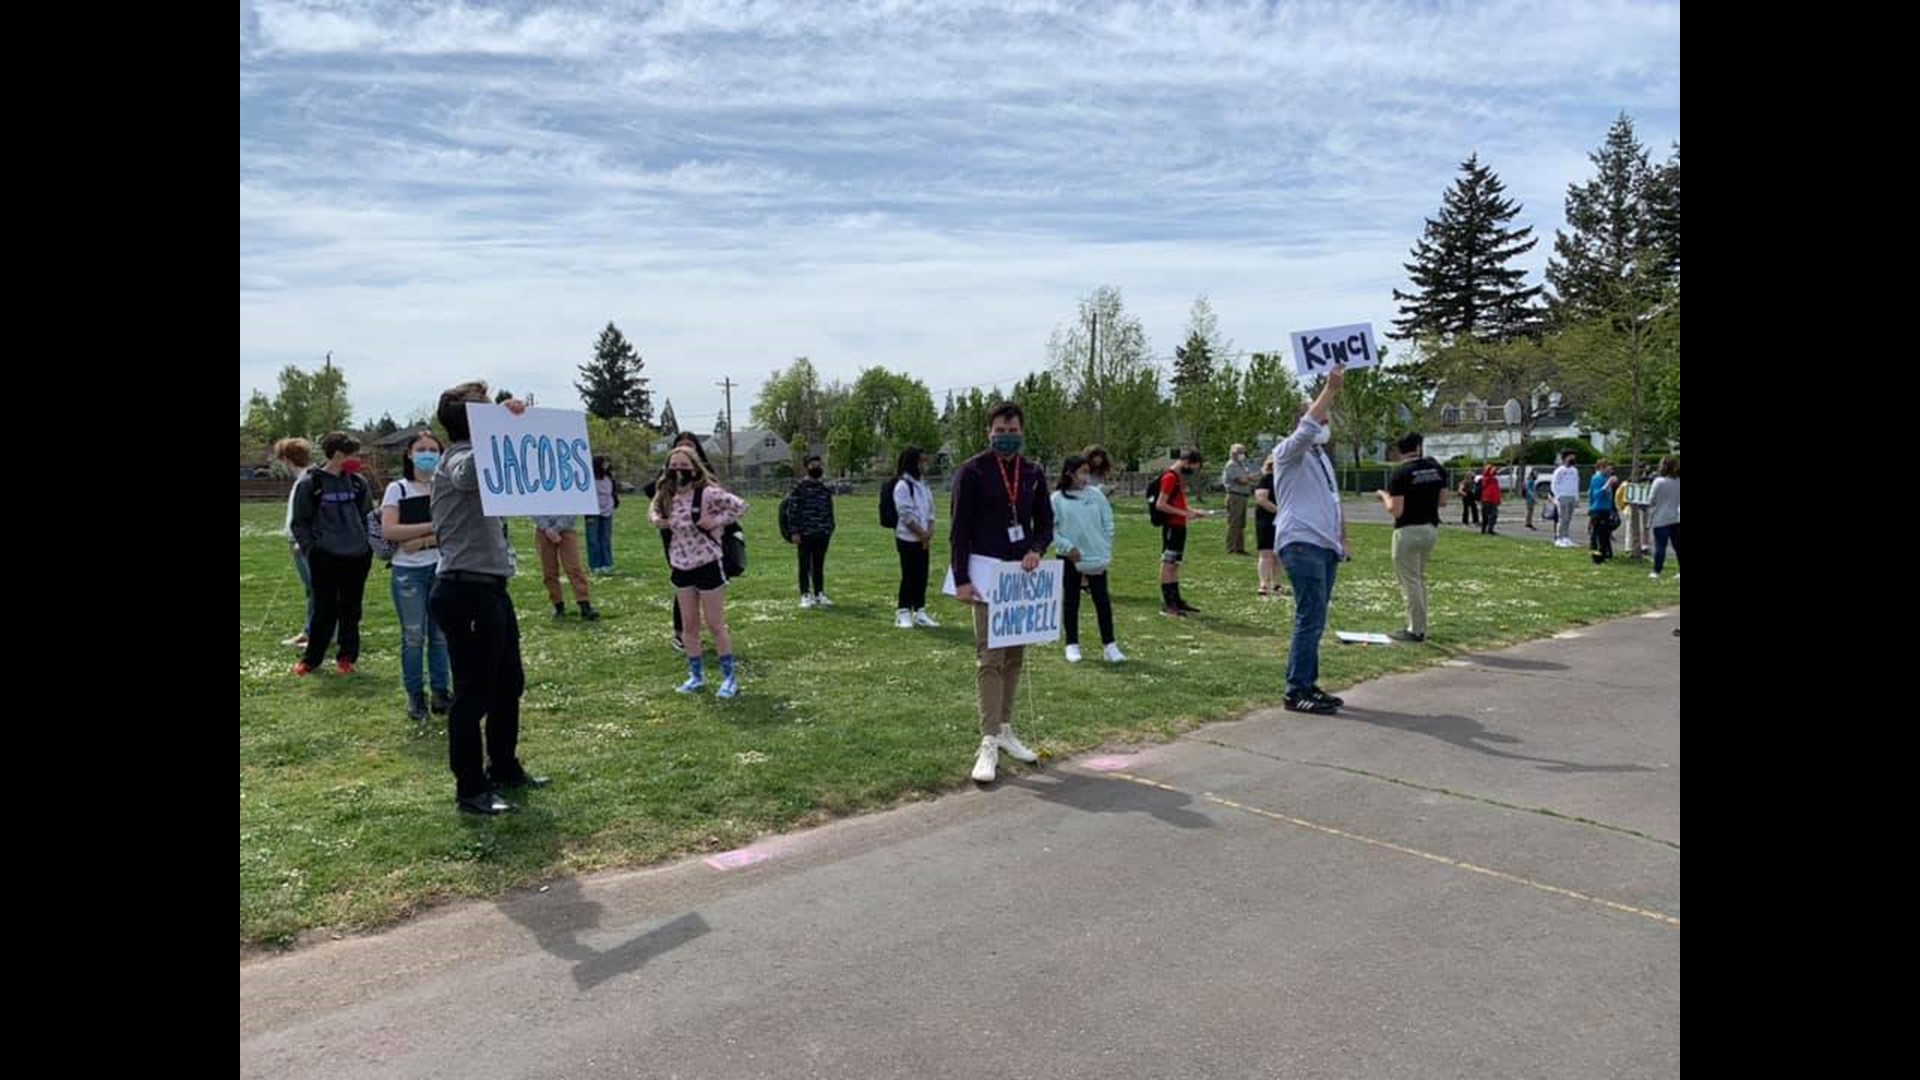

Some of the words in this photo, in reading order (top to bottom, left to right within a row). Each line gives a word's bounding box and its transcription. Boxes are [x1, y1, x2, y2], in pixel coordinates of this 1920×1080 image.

[483, 433, 591, 495] JACOBS
[993, 569, 1055, 605] JOHNSON
[992, 600, 1058, 637] CAMPBELL
